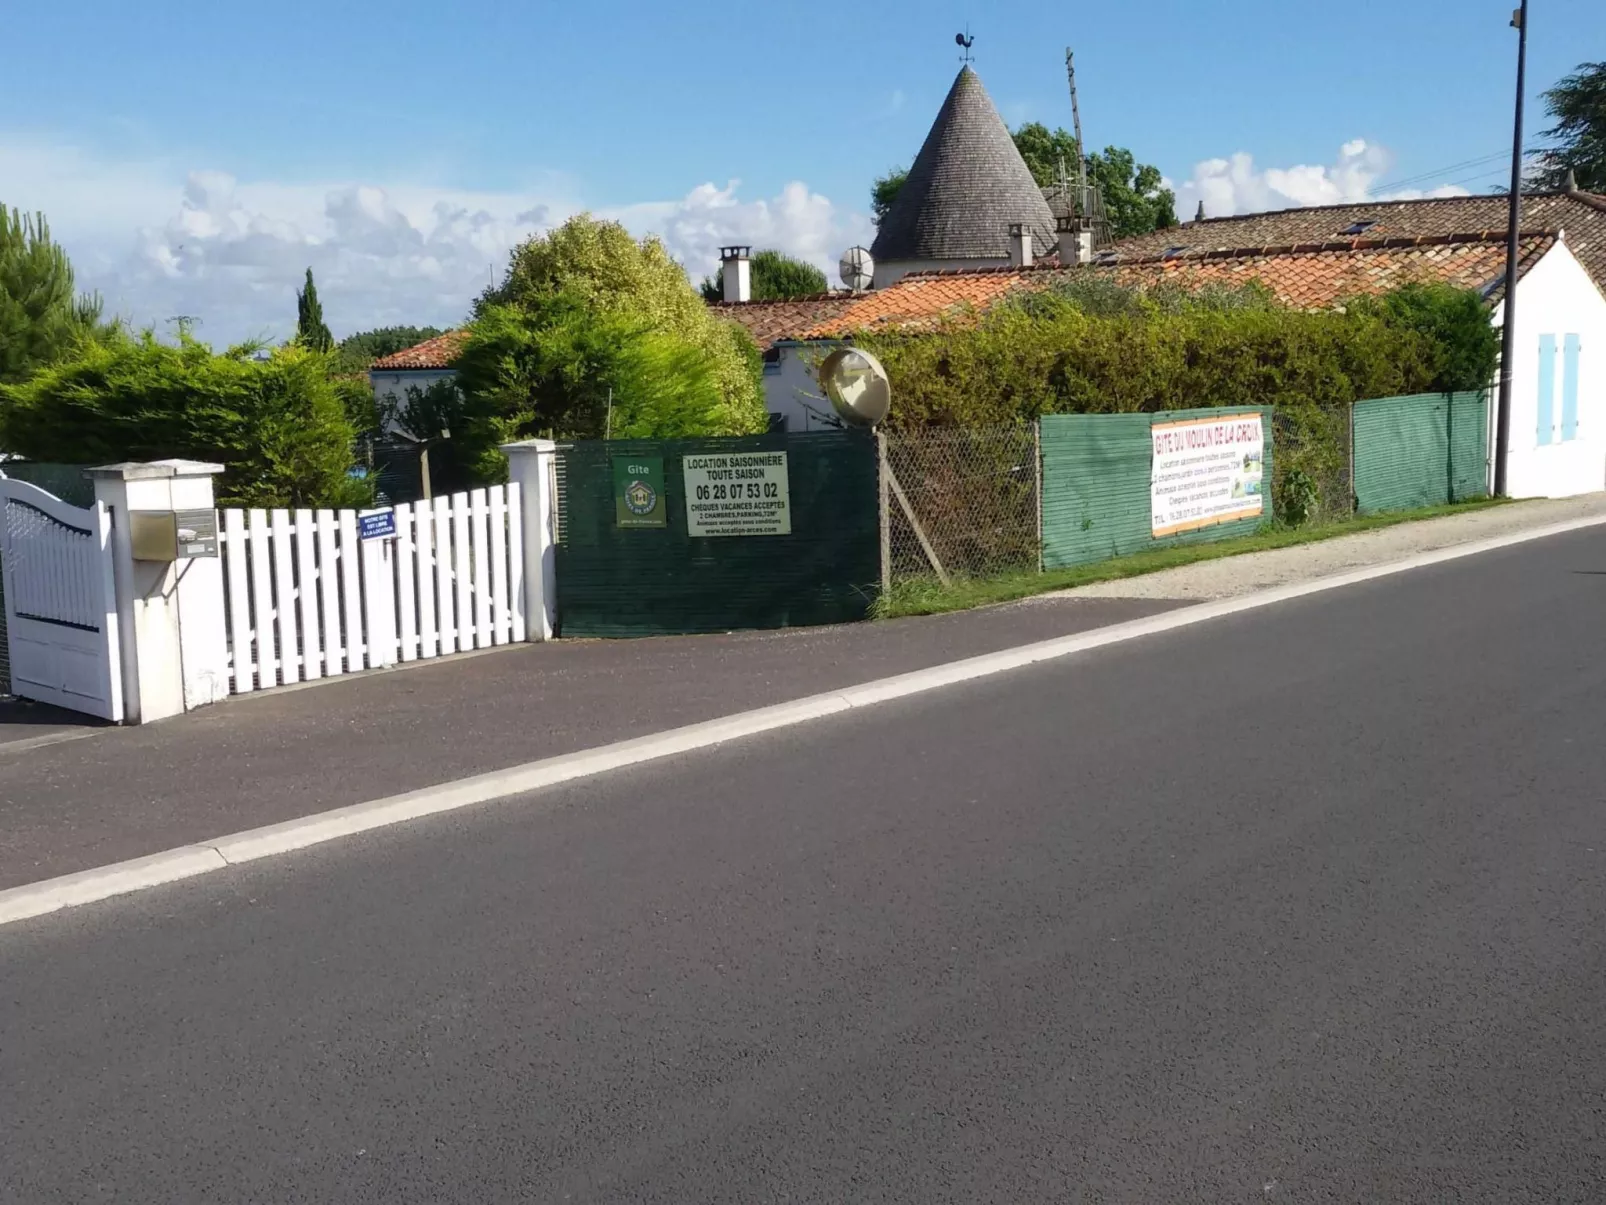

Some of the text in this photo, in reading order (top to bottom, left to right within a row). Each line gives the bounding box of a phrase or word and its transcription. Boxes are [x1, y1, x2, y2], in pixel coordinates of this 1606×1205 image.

[1155, 422, 1260, 455] GITE DU MOULIN DE LA CROIX
[687, 454, 783, 469] LOCATION SAISONNIÈRE
[707, 468, 765, 480] TOUTE SAISON
[696, 482, 778, 500] 06 28 07 53 02
[720, 502, 753, 511] VACANCES
[705, 527, 777, 535] www.location-arces.com
